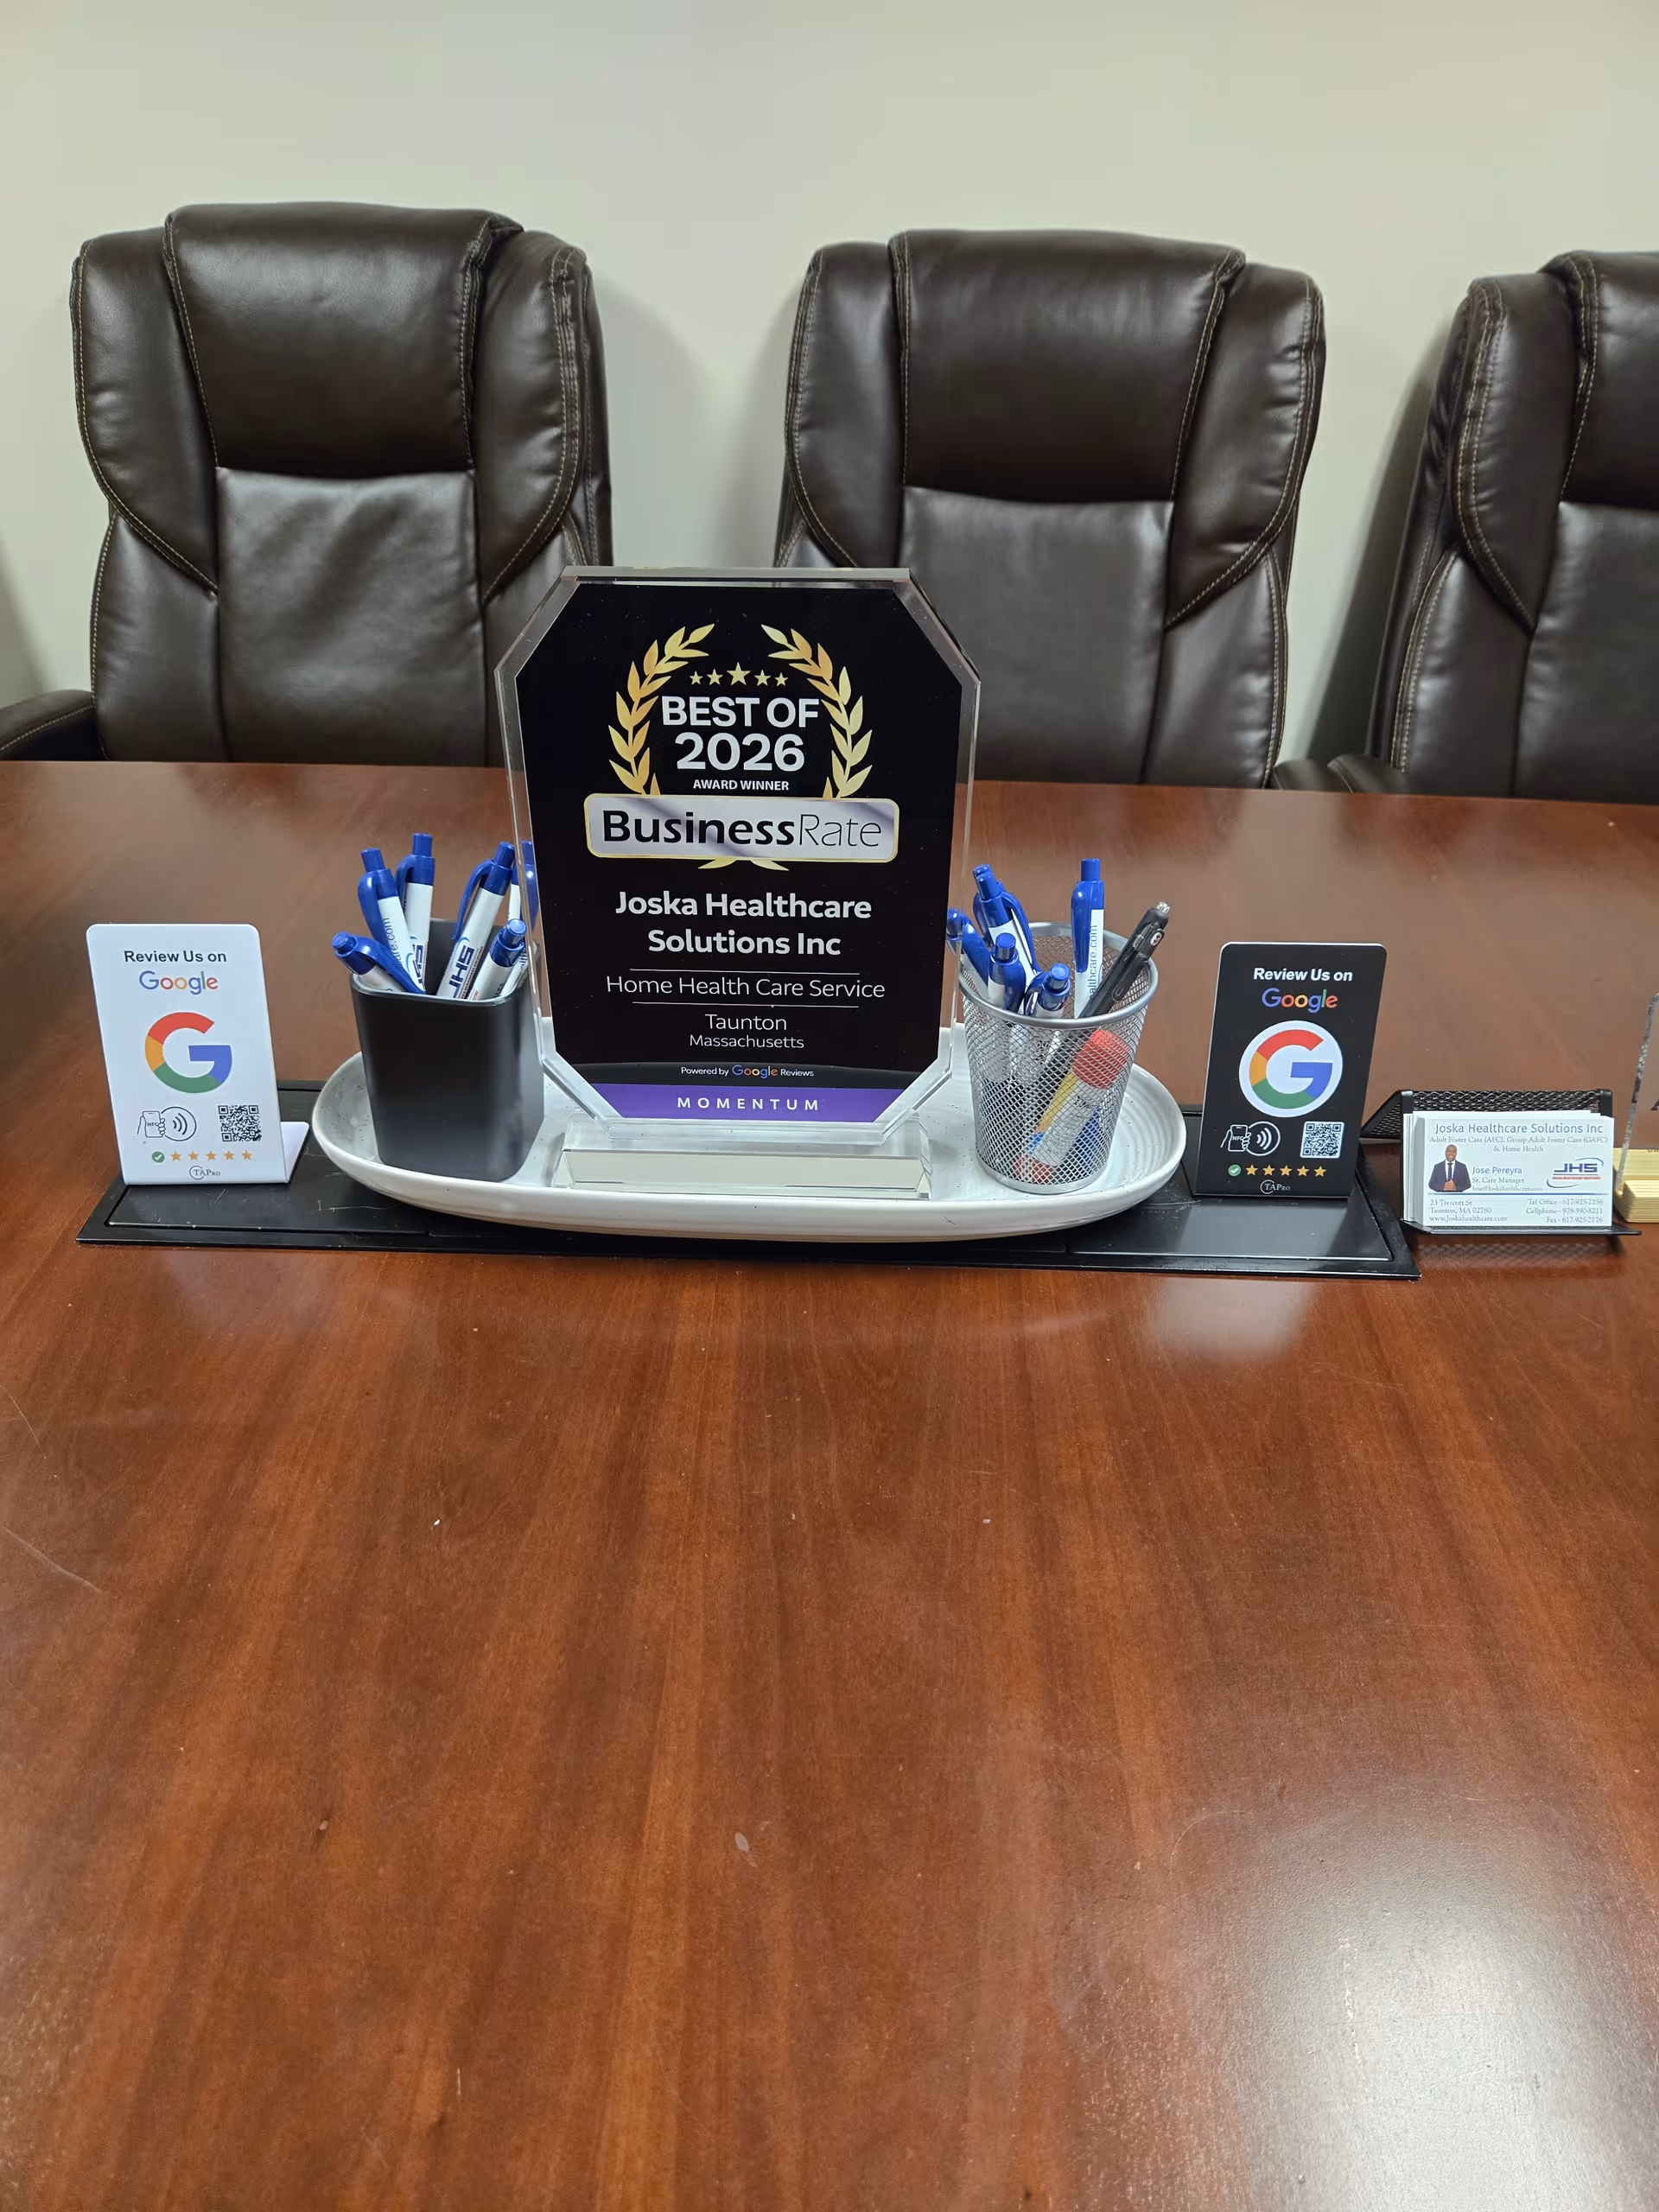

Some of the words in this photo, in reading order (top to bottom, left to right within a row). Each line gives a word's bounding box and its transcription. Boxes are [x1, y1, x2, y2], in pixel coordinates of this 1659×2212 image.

[662, 696, 760, 728] BEST
[766, 697, 820, 728] OF
[674, 732, 805, 772] 2026
[692, 779, 738, 791] AWARD
[740, 780, 790, 791] WINNER
[602, 810, 881, 848] BusinessRate
[615, 891, 697, 916] Joska
[706, 893, 872, 918] Healthcare
[647, 929, 791, 955] Solutions
[798, 933, 841, 956] Inc
[124, 950, 179, 963] Review
[183, 950, 204, 963] Us
[207, 952, 227, 963] on
[139, 970, 219, 995] Google
[1253, 967, 1307, 982] Review
[1311, 968, 1331, 982] Us
[1333, 970, 1353, 982] on
[606, 975, 673, 995] Home
[679, 977, 750, 996] Health
[756, 978, 804, 997] Care
[809, 978, 886, 998] Service
[1262, 988, 1338, 1014] Google
[704, 1014, 788, 1031] Taunton
[690, 1034, 804, 1049] Massachusetts
[681, 1065, 717, 1076] Powered
[718, 1066, 729, 1077] by
[732, 1065, 778, 1078] Google
[780, 1068, 814, 1077] Reviews
[677, 1096, 819, 1111] MOMENTUM
[1435, 1123, 1464, 1134] Joska
[1468, 1123, 1528, 1133] Healthcare
[1530, 1123, 1583, 1133] Solutions
[1586, 1123, 1604, 1133] Inc
[1471, 1166, 1490, 1175] Jose
[1492, 1166, 1522, 1175] Pereyra
[1554, 1163, 1598, 1173] JHS
